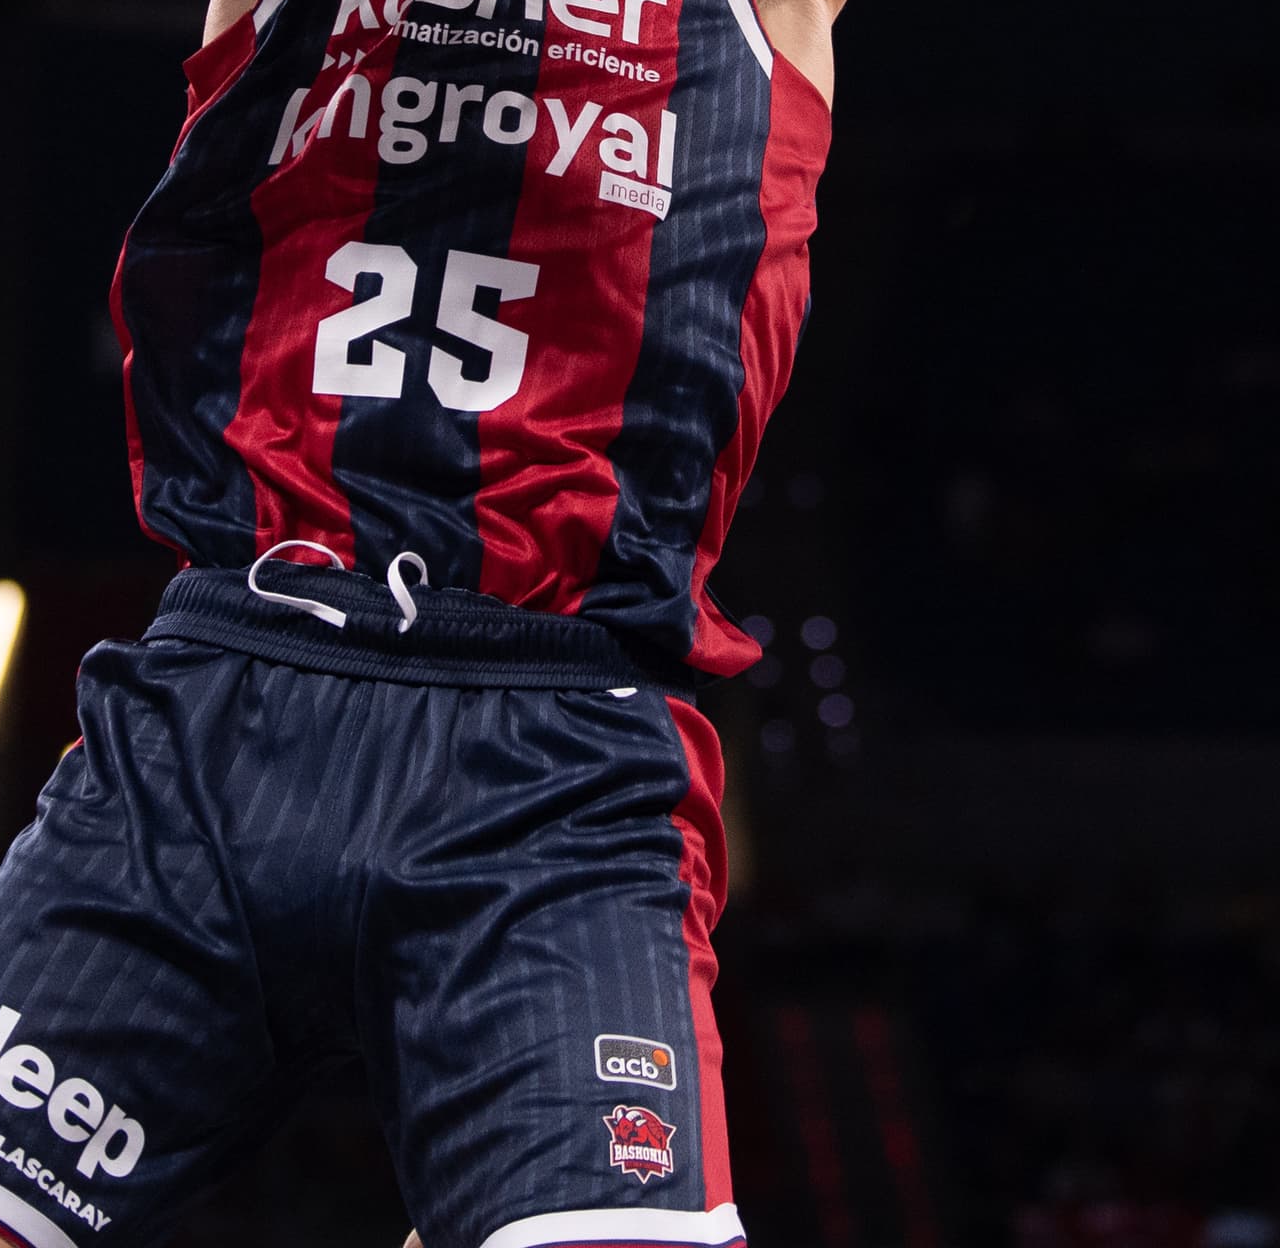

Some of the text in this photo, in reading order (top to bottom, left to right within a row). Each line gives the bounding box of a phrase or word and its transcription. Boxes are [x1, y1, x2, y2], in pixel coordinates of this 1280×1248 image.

[548, 43, 661, 83] eficiente
[267, 73, 678, 189] kngroyal
[312, 240, 540, 412] 25
[606, 1056, 659, 1080] acb
